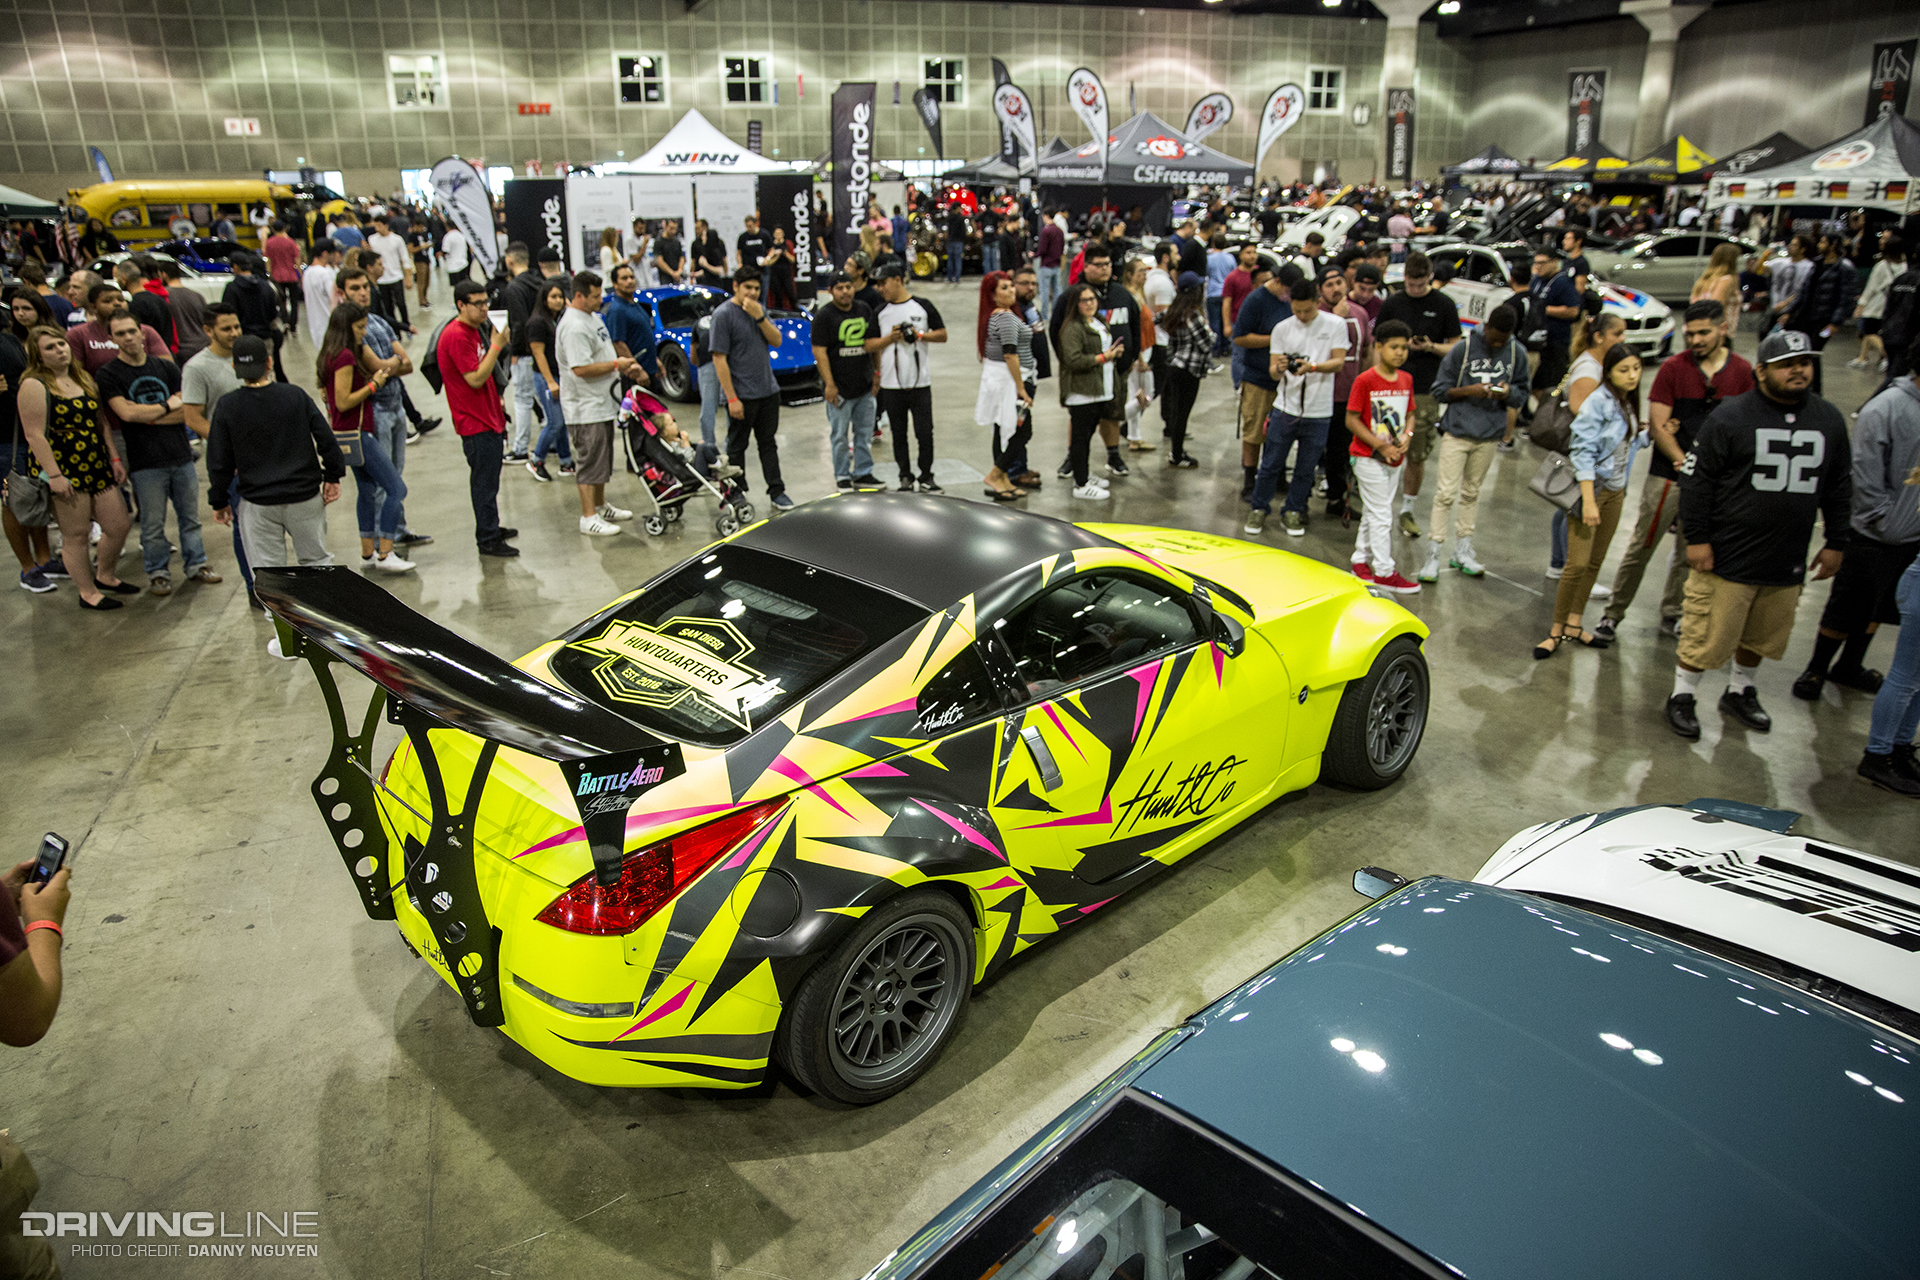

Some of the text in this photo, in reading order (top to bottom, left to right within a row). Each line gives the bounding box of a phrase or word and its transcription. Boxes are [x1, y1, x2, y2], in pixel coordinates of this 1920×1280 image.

[1133, 164, 1229, 185] CSFrace.com
[1751, 428, 1825, 494] 52
[678, 627, 726, 651] SAN DIEGO
[623, 635, 729, 686] HUNTQUARTERS
[621, 667, 662, 691] EST. 2016
